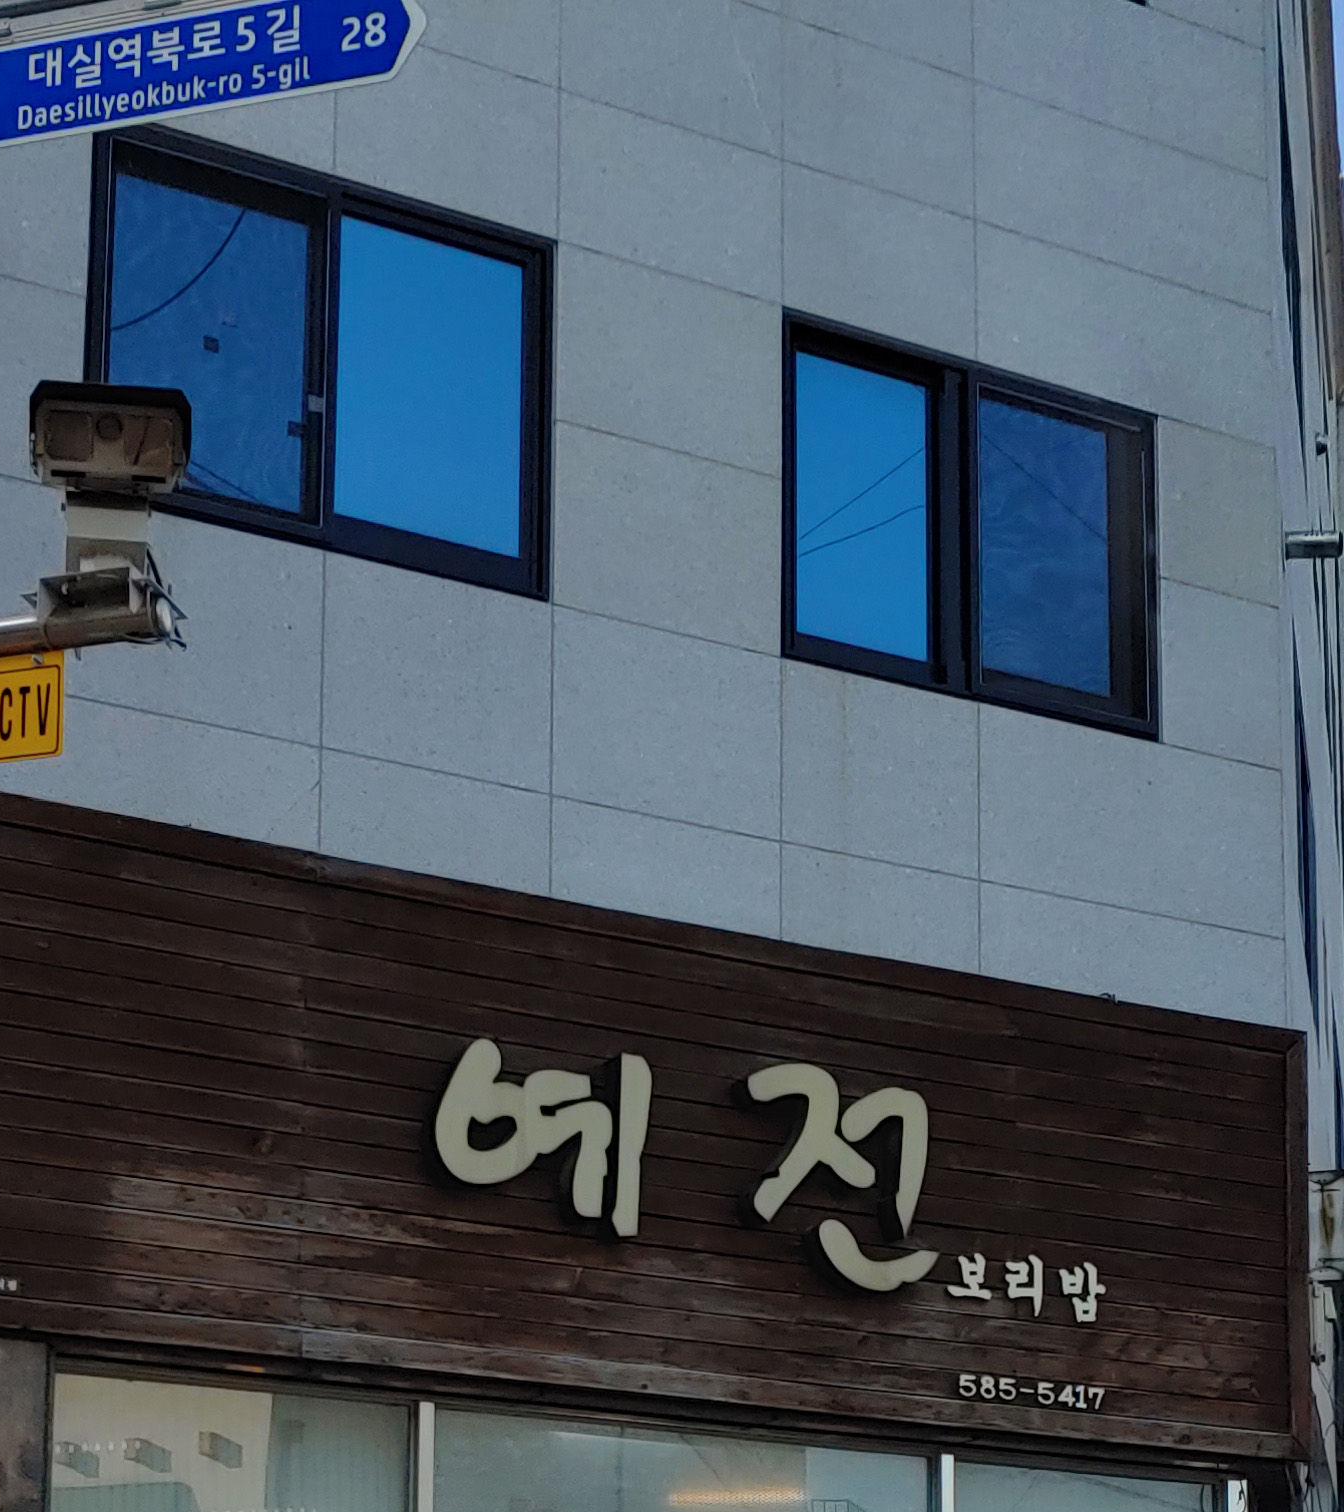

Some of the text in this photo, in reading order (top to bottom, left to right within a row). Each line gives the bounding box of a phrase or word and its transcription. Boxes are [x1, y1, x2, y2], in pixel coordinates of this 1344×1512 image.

[339, 12, 387, 53] 28
[16, 56, 312, 131] Daesillyeokbuk-ro 5-gil
[946, 1252, 1107, 1323] 보리밥
[957, 1373, 1106, 1412] 585-5417
